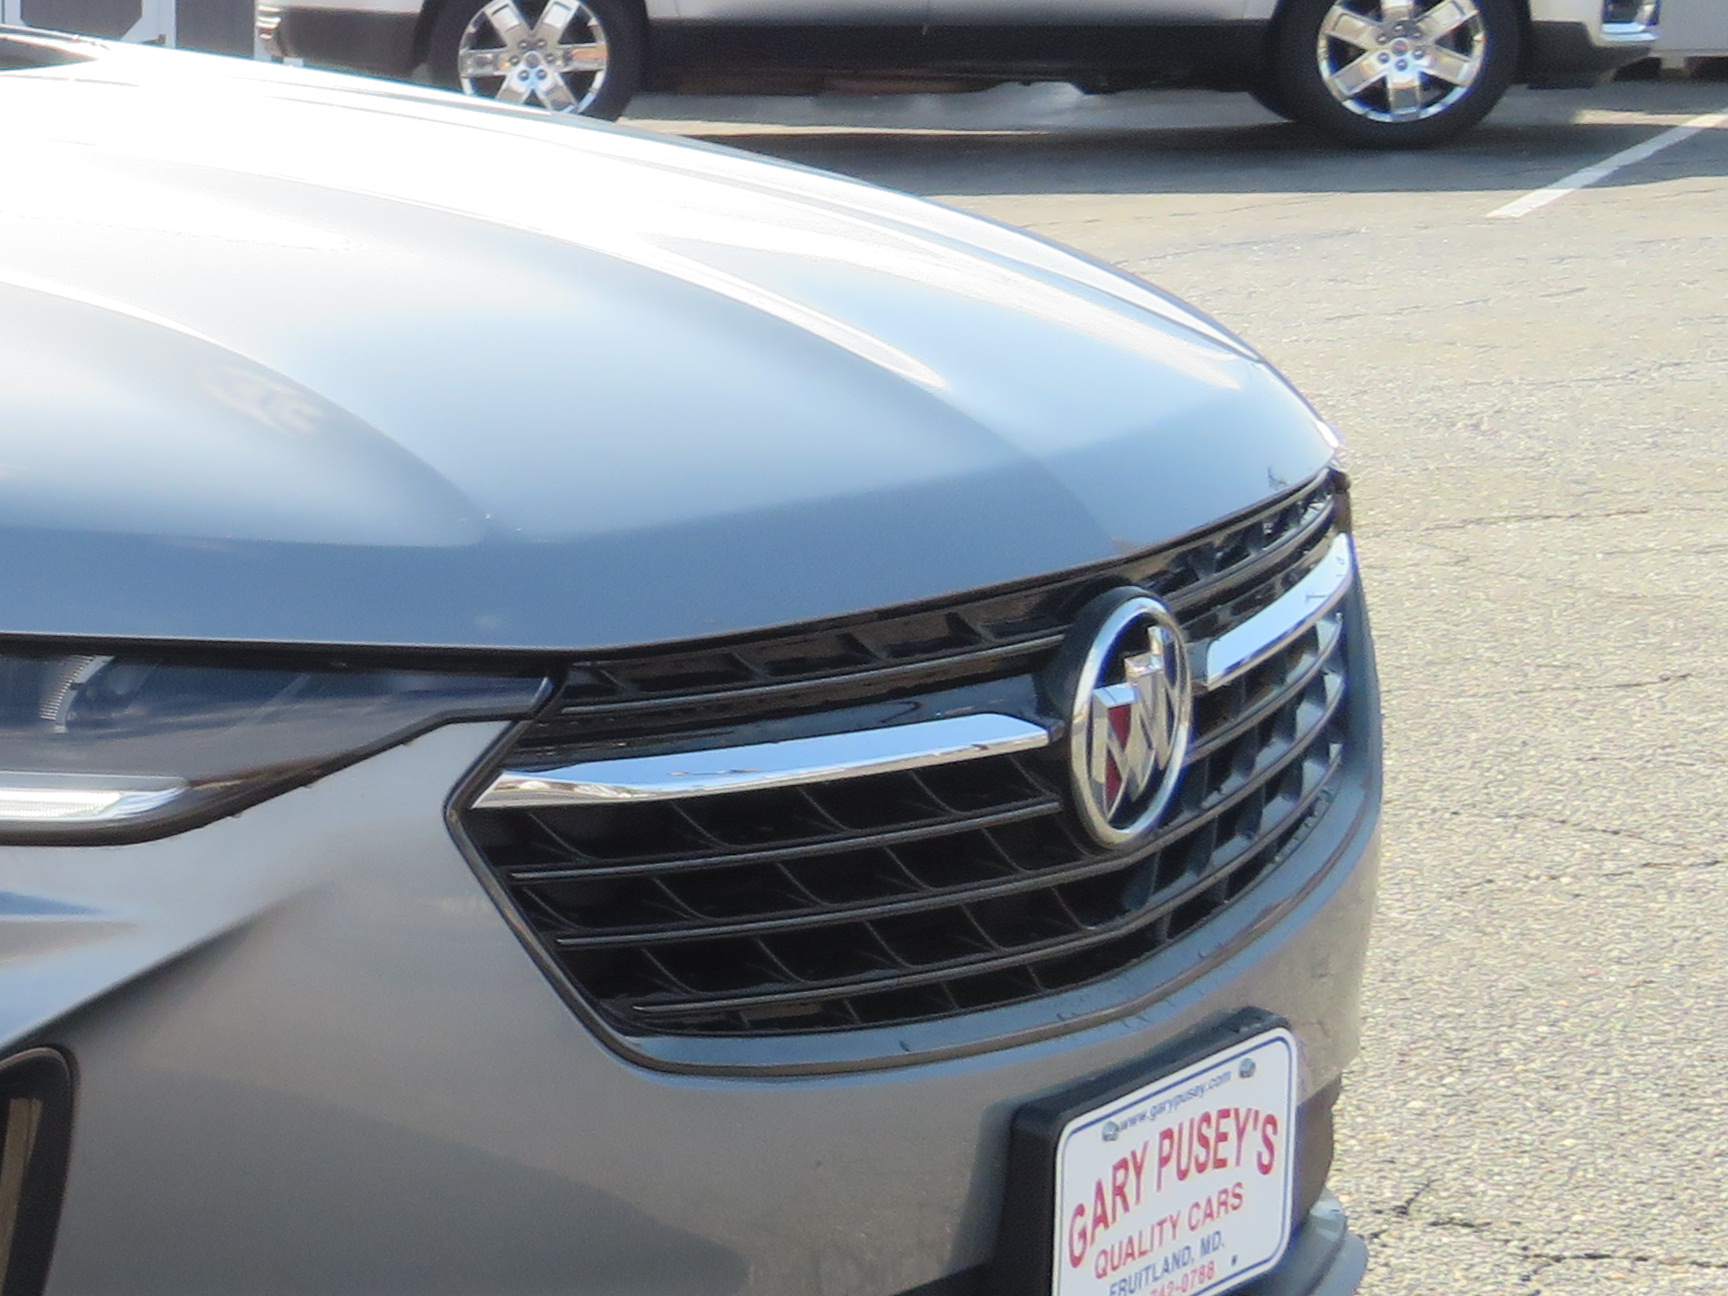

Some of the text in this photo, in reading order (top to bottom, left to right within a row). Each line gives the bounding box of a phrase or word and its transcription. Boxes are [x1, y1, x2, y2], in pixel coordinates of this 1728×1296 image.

[1069, 1107, 1279, 1269] GARY PUSEY'S
[1094, 1181, 1245, 1279] QUALITY CARS
[1200, 1230, 1226, 1257] MD.
